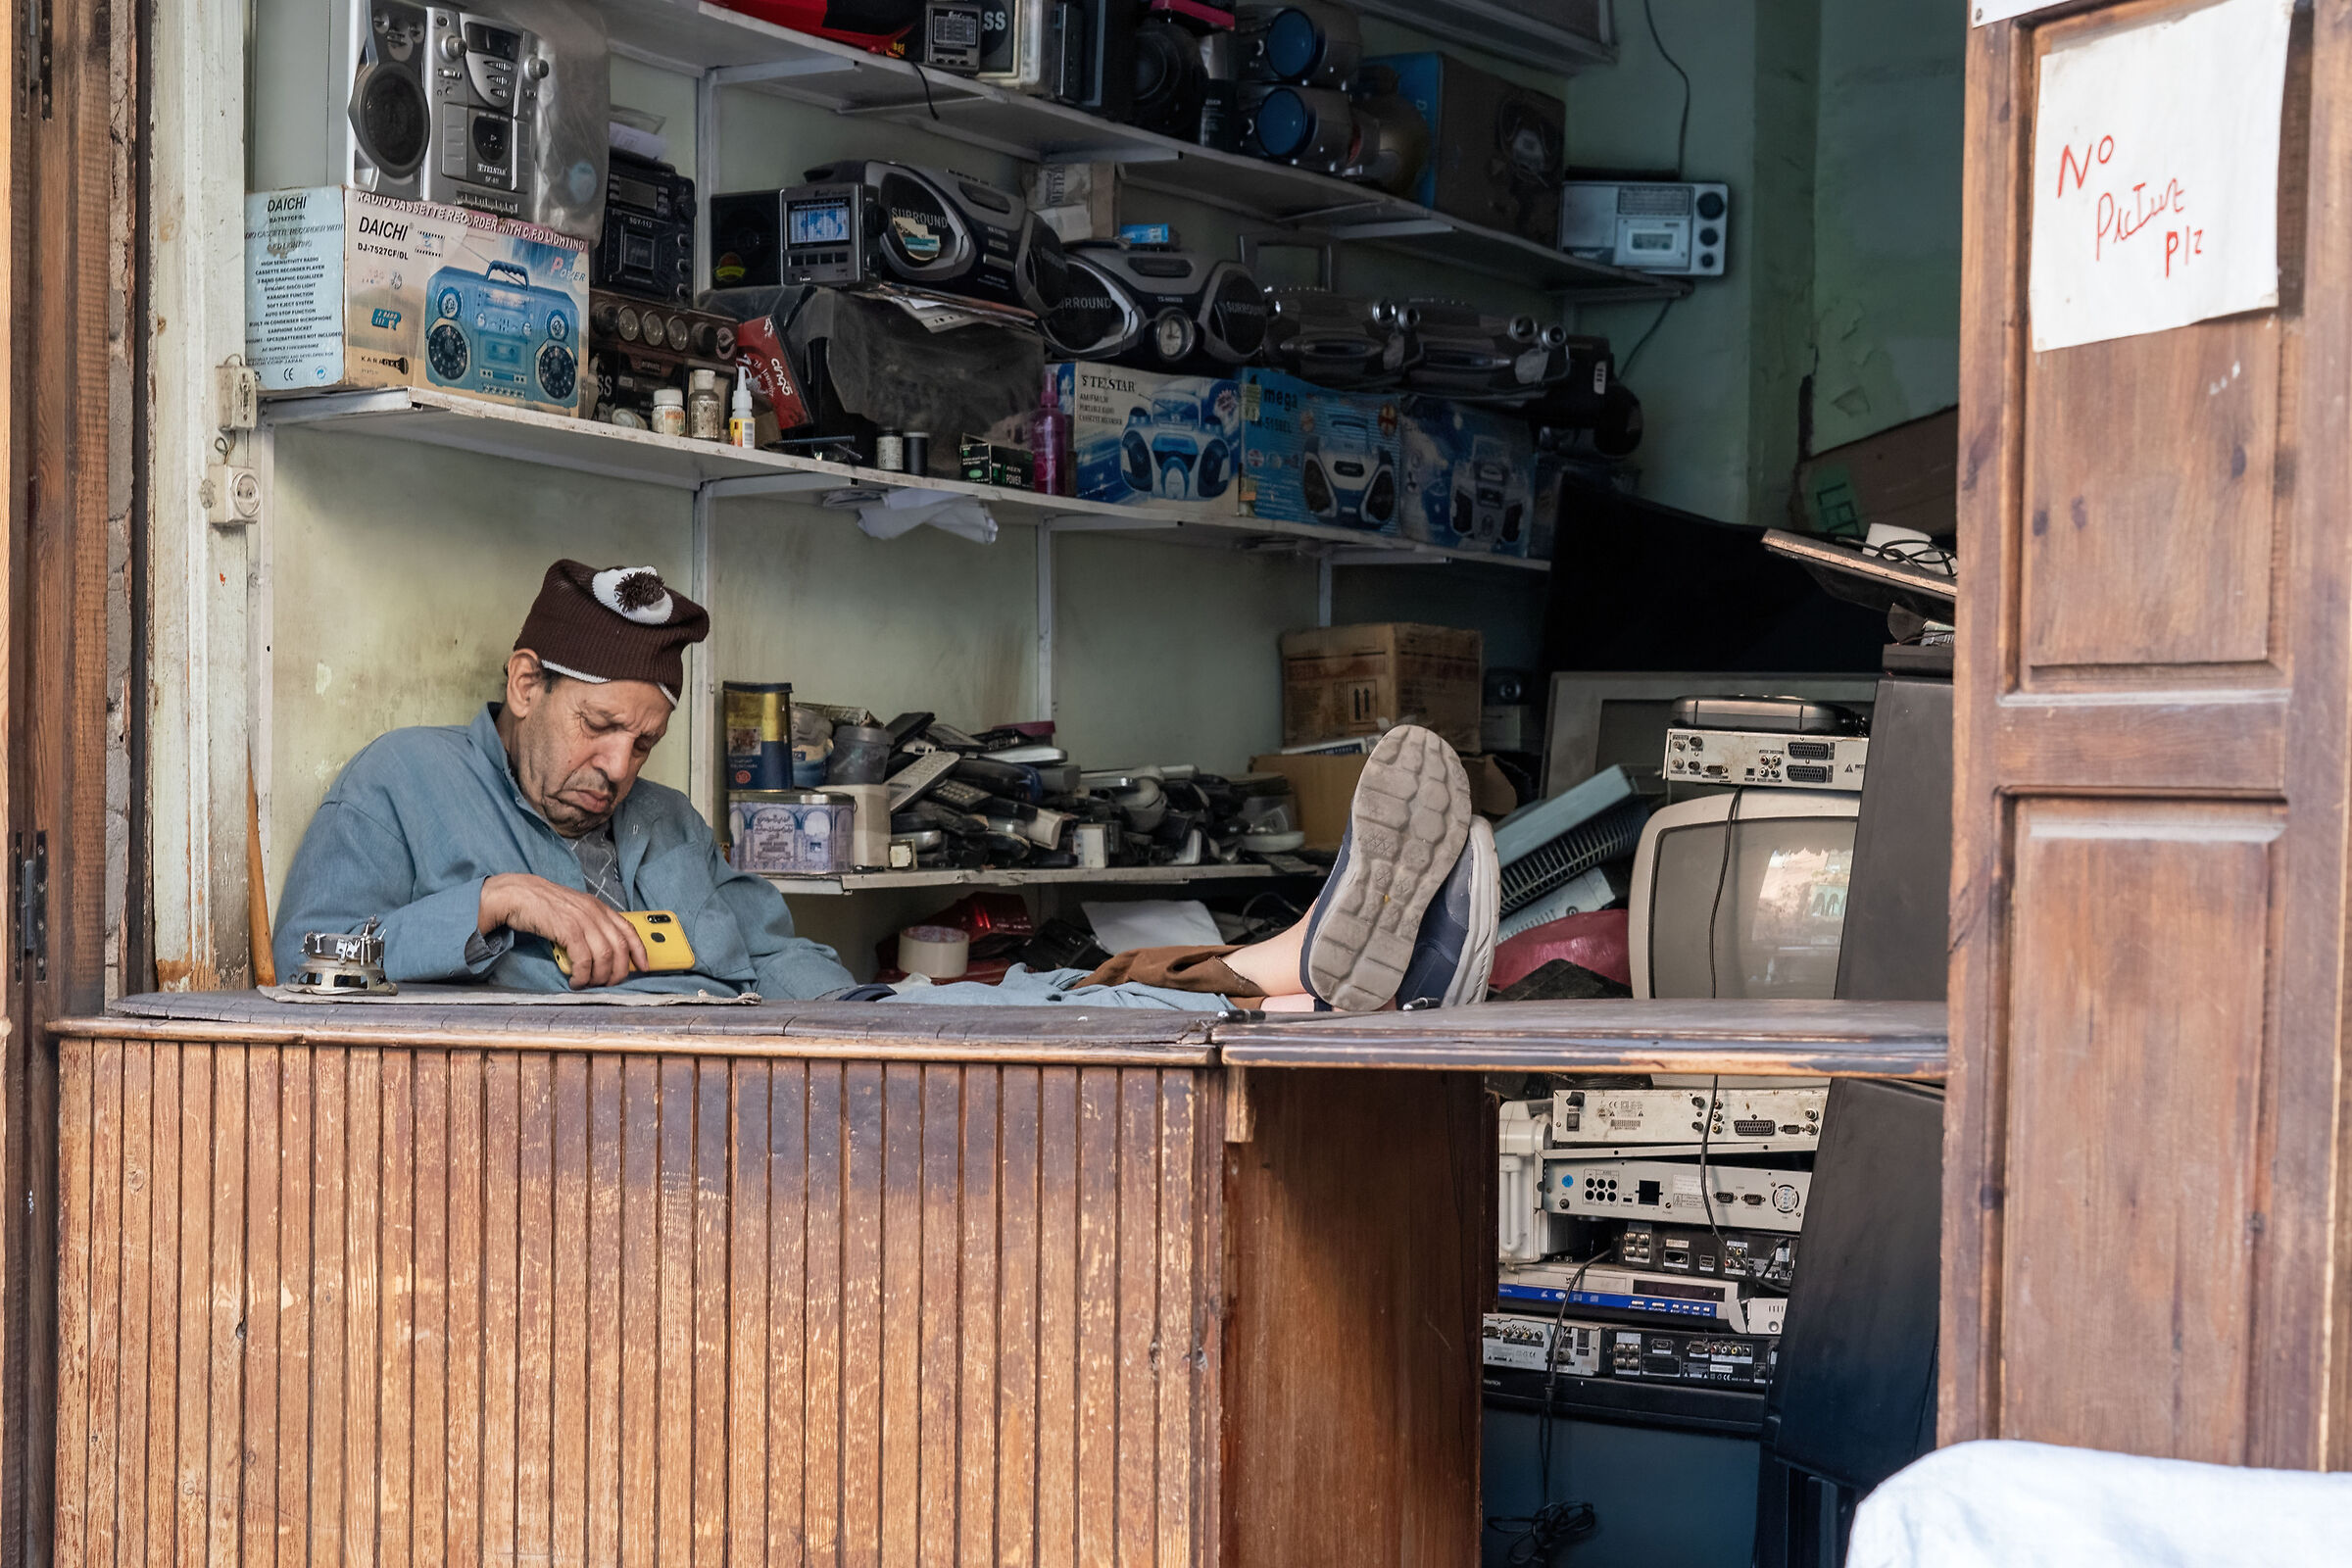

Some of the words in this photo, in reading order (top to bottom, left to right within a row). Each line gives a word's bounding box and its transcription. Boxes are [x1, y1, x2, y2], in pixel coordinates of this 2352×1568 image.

[267, 195, 308, 213] DAICHI
[358, 216, 410, 241] DAICHI
[447, 209, 498, 233] RECORDER
[545, 230, 585, 251] LIGHTING
